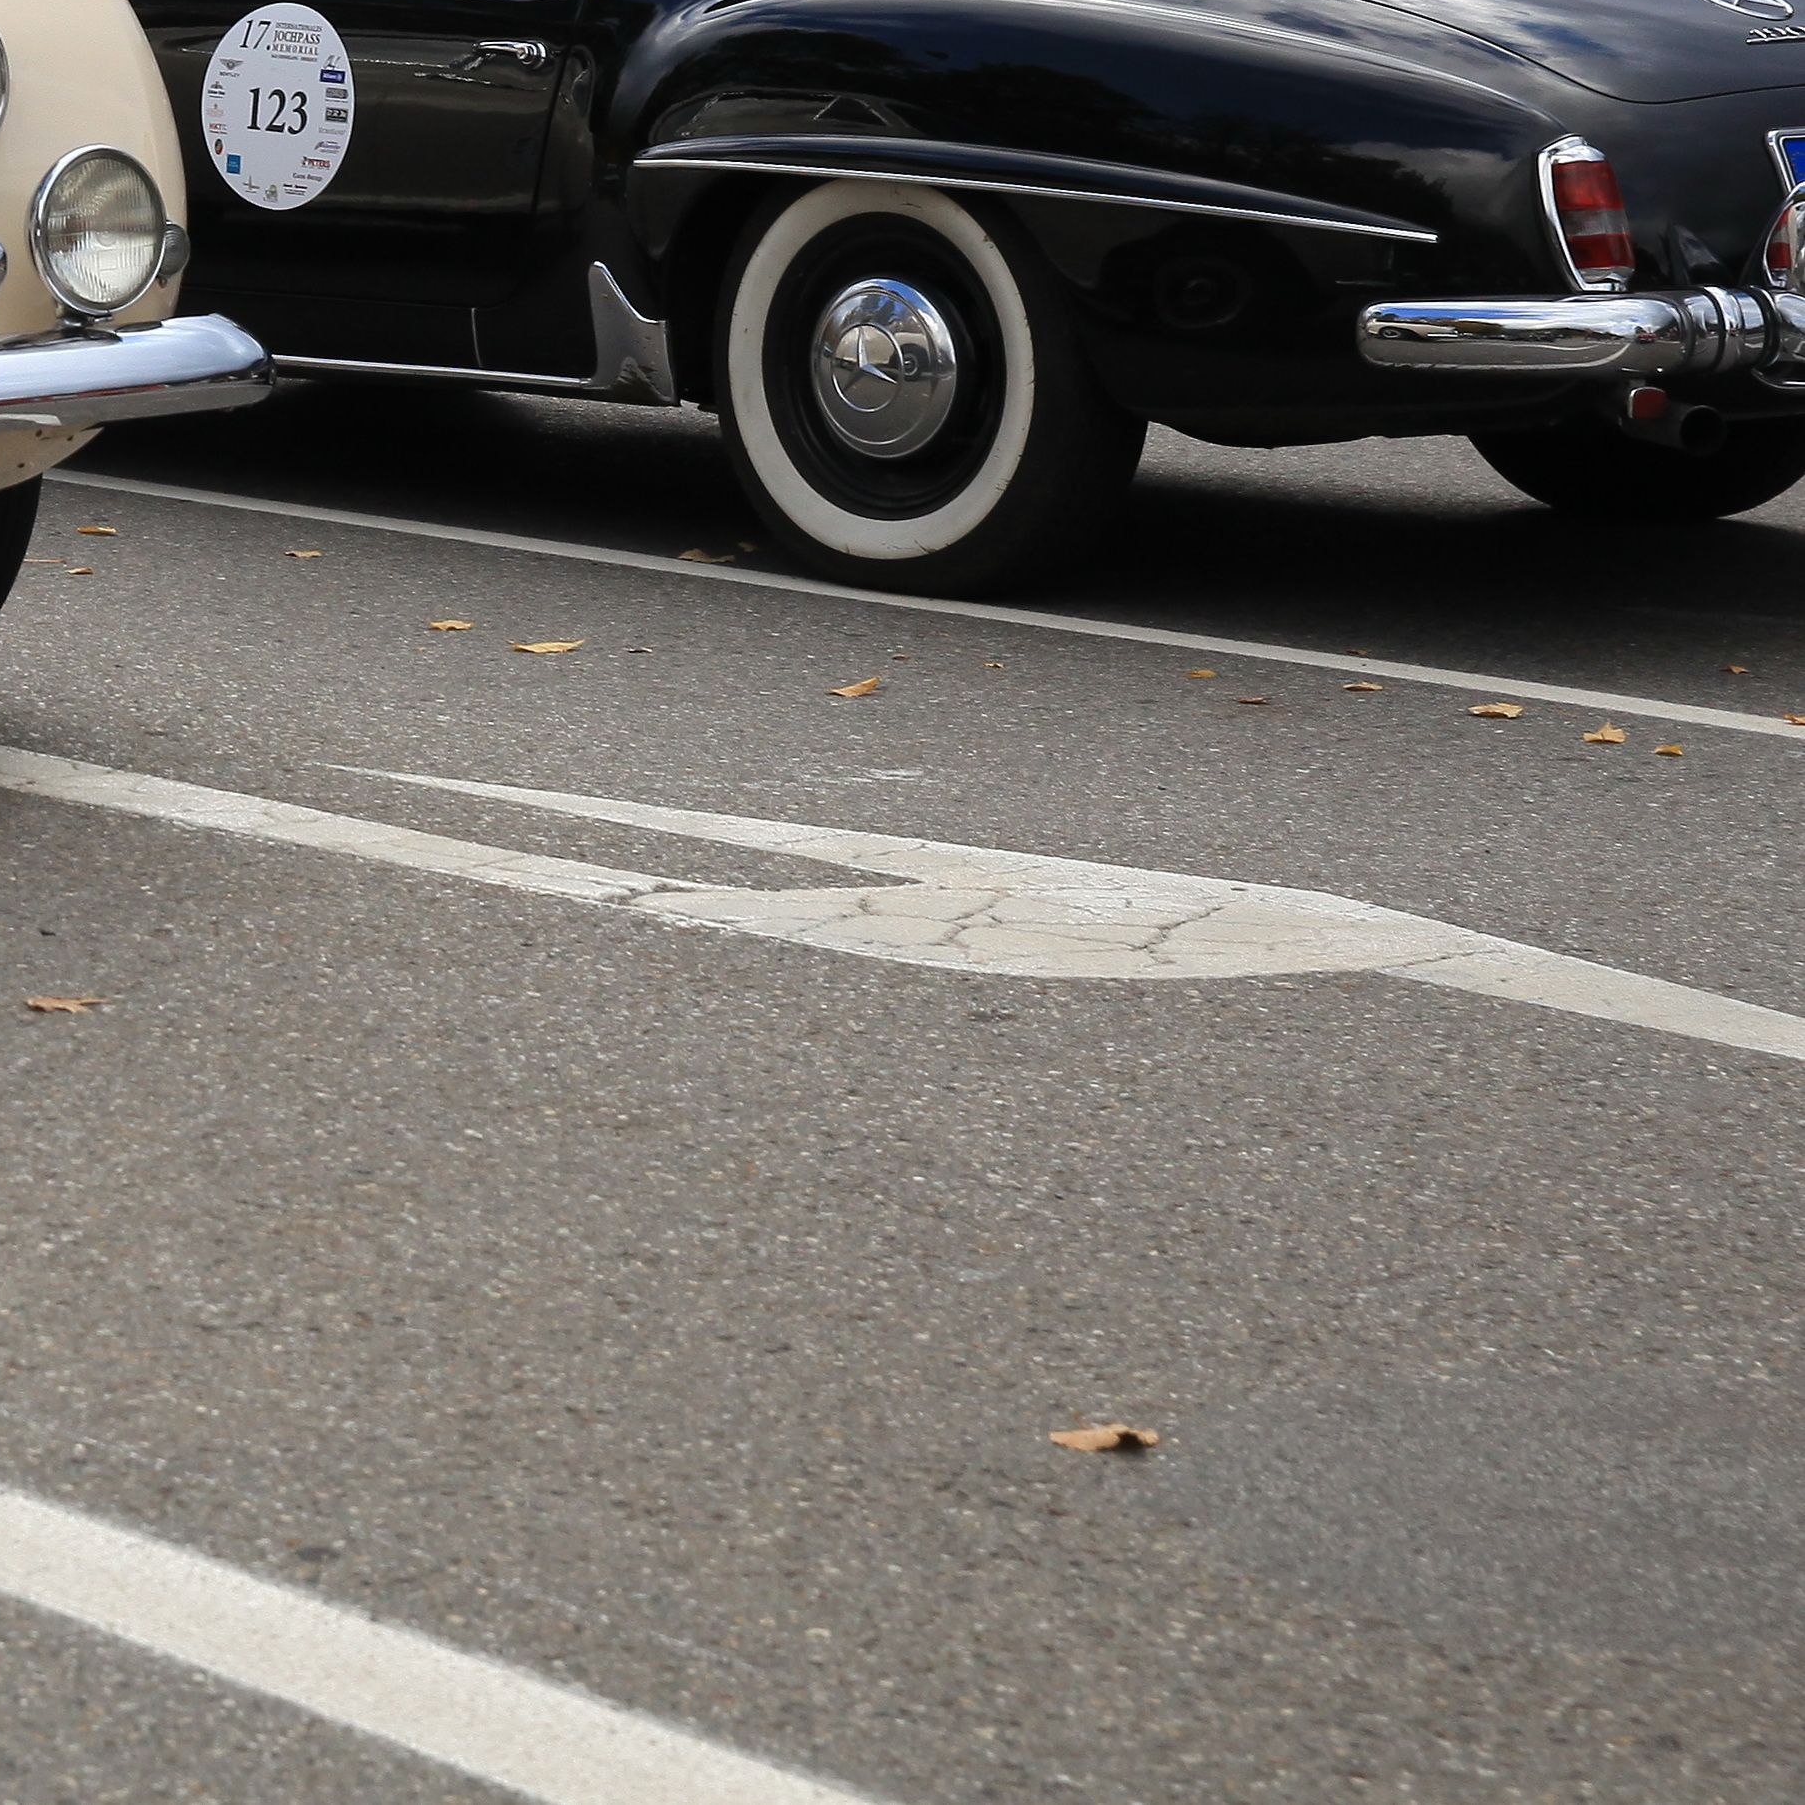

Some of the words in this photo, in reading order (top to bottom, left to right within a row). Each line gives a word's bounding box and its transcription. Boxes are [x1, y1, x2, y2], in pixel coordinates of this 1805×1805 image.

[239, 20, 271, 51] 17.
[273, 30, 321, 44] JOCHPASS
[272, 43, 318, 56] MEMORIAL
[247, 87, 308, 135] 123
